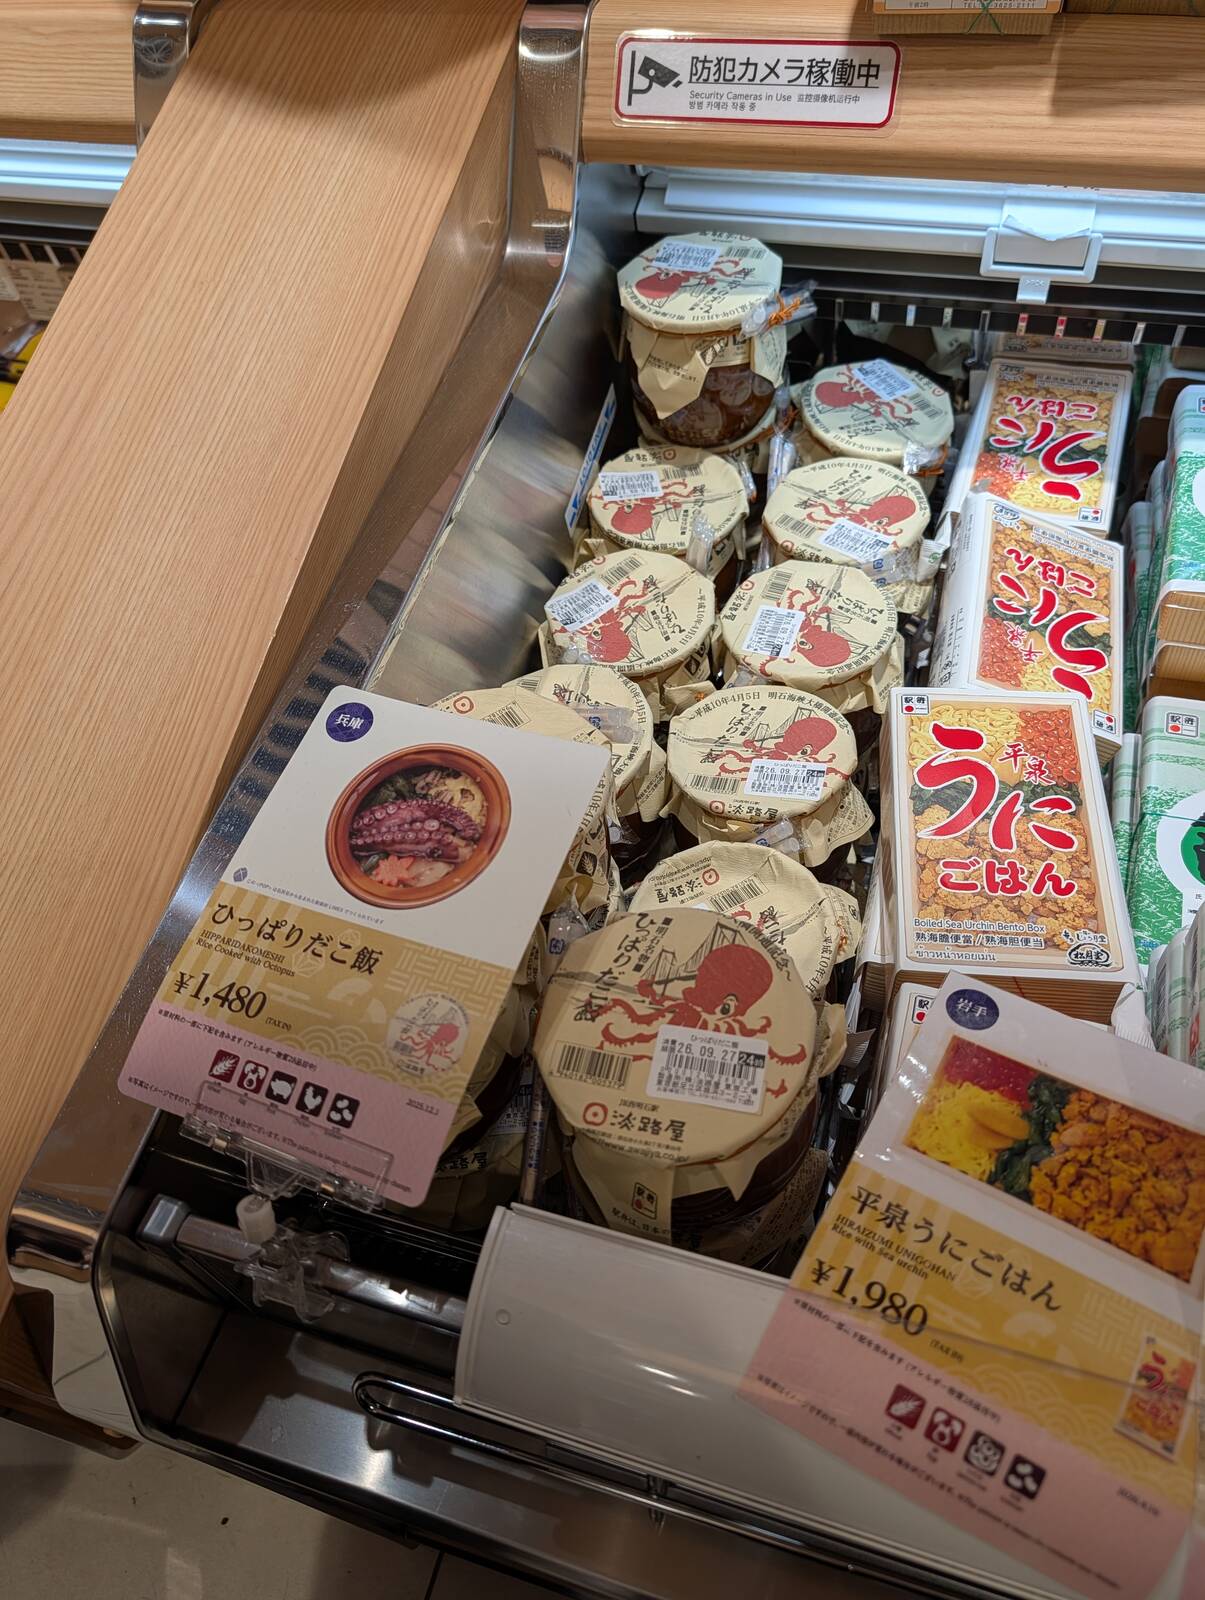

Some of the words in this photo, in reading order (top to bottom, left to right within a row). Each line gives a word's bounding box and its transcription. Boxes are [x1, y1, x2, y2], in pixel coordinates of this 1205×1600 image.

[689, 55, 880, 87] 防犯カメラ稼働中
[689, 90, 725, 101] Security
[726, 92, 762, 101] Cameras
[765, 93, 773, 101] in
[775, 93, 792, 102] Use
[1006, 548, 1096, 598] ごはん
[335, 713, 365, 730] 兵庫
[999, 743, 1056, 785] 平泉
[915, 722, 1077, 851] うに
[728, 804, 779, 819] 淡路屋
[939, 858, 1077, 897] ごはん
[212, 902, 384, 976] ひっぱりだこ飯
[914, 918, 943, 928] Boiled
[945, 920, 962, 929] Sea
[965, 920, 995, 930] Urchin
[998, 922, 1025, 932] Bento
[1027, 923, 1045, 932] Box
[195, 938, 213, 950] Rice
[214, 943, 243, 961] Cooked
[244, 952, 262, 965] with
[263, 960, 296, 978] Octopus
[200, 928, 285, 964] HIPPARIDAKOMESHI
[173, 971, 268, 1019] ¥1,480
[956, 998, 987, 1017] 岩手
[610, 1111, 686, 1143] 淡路屋
[831, 1222, 851, 1241] Rice
[854, 1235, 876, 1253] with
[877, 1248, 894, 1262] Sea
[896, 1258, 929, 1280] urchin
[836, 1213, 894, 1249] HIRAIZUMI
[895, 1243, 957, 1281] UNIGOHAN
[850, 1184, 1063, 1313] 平泉うにごはん
[811, 1258, 928, 1336] ¥1,980
